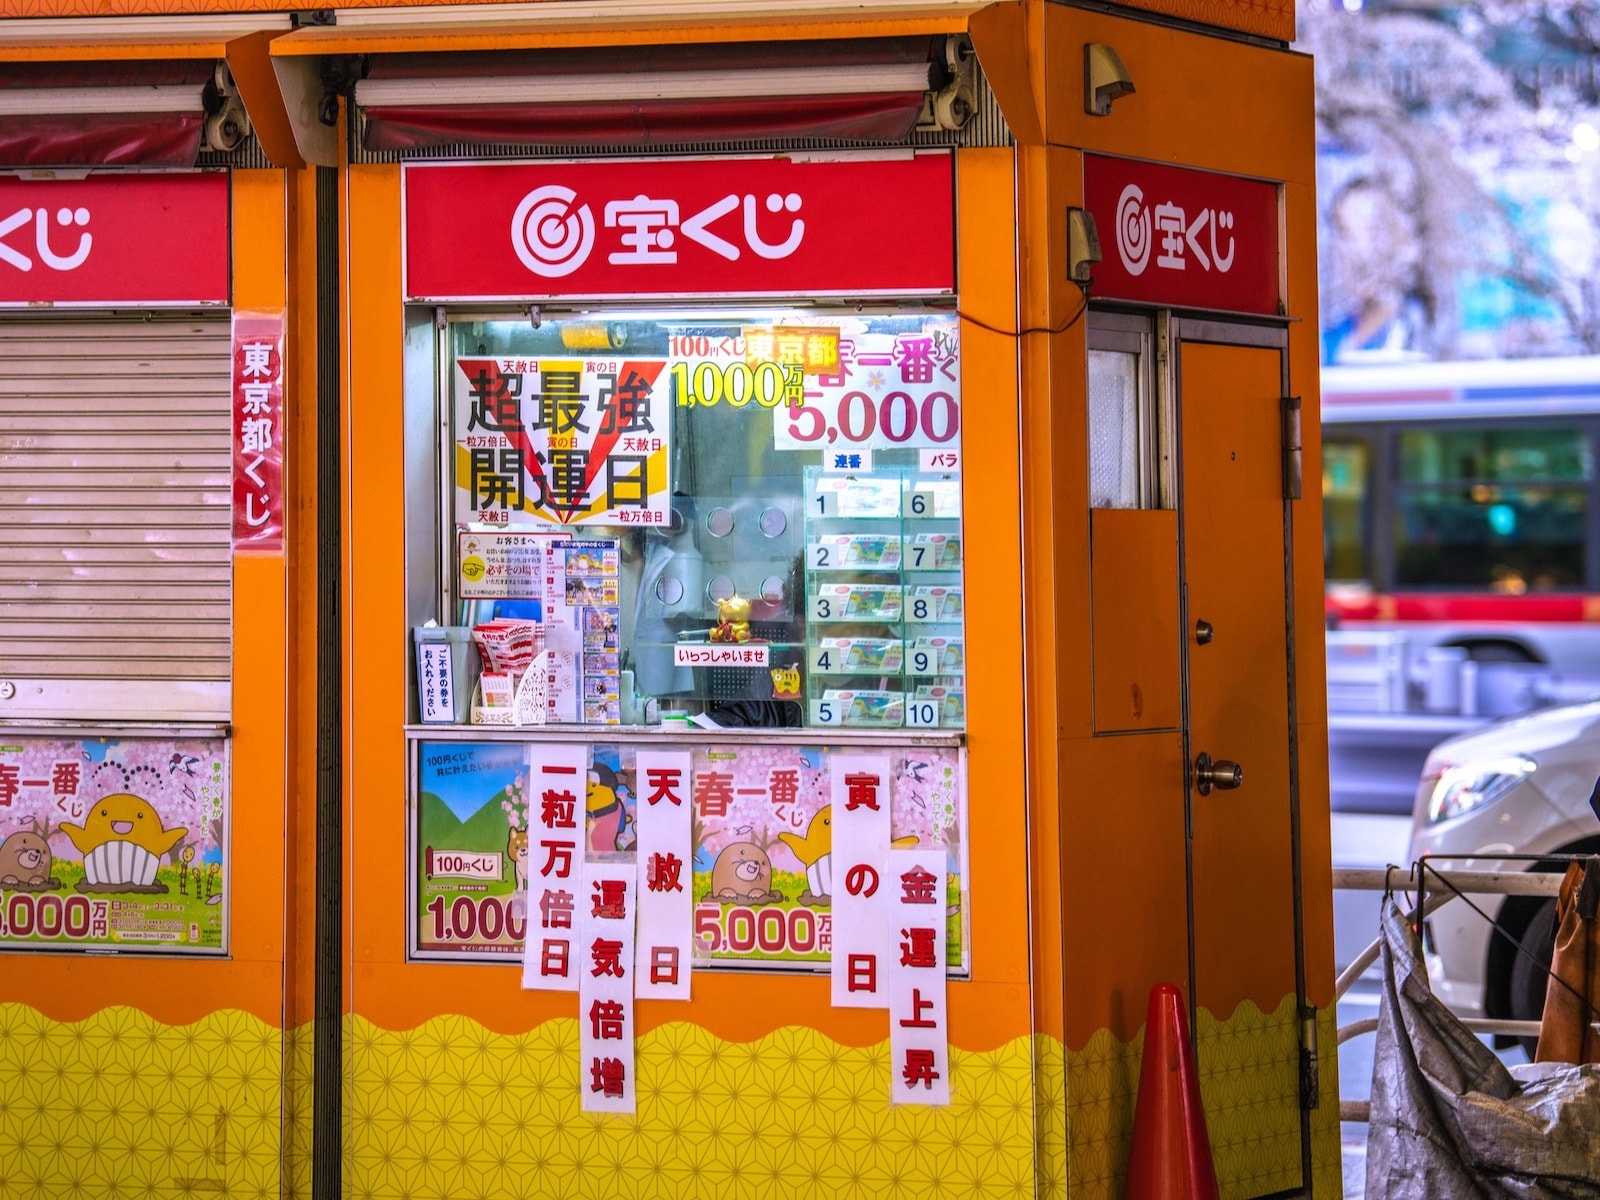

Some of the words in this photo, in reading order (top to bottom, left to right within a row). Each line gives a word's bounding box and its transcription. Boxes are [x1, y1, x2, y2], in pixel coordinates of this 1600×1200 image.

[604, 192, 805, 265] 宝くじ
[1154, 200, 1235, 273] 宝くじ
[745, 333, 838, 367] 東京都
[503, 360, 539, 374] 天赦日
[585, 360, 617, 373] 寅の日
[467, 368, 655, 436] 超最強
[788, 391, 959, 444] 5,000
[240, 342, 274, 527] 東京都くじ
[457, 436, 507, 448] 一粒万倍日
[547, 436, 578, 449] 寅の日
[623, 437, 661, 452] 天赦日
[834, 453, 862, 470] 連番
[470, 448, 649, 512] 開運日
[816, 495, 825, 514] 1
[911, 494, 926, 514] 6
[478, 510, 509, 523] 天赦日
[608, 511, 663, 523] 一粒万倍日
[496, 536, 536, 546] お客さまへ
[816, 547, 830, 567] 2
[912, 547, 926, 567] 7
[817, 599, 831, 619] 3
[913, 599, 928, 619] 8
[817, 651, 832, 670] 4
[914, 652, 928, 672] 9
[424, 650, 436, 716] お入れください
[438, 649, 449, 708] ご不要の券を
[819, 703, 832, 722] 5
[909, 704, 934, 724] 10
[694, 768, 800, 818] 春一番
[57, 797, 83, 818] くじ
[775, 804, 804, 828] くじ
[437, 856, 494, 872] 100円くじ
[538, 765, 577, 978] 一粒万倍日
[646, 769, 683, 985] 天赦日
[844, 771, 881, 993] 寅の日
[900, 864, 939, 1090] 金運上昇
[589, 879, 626, 1098] 運気倍増
